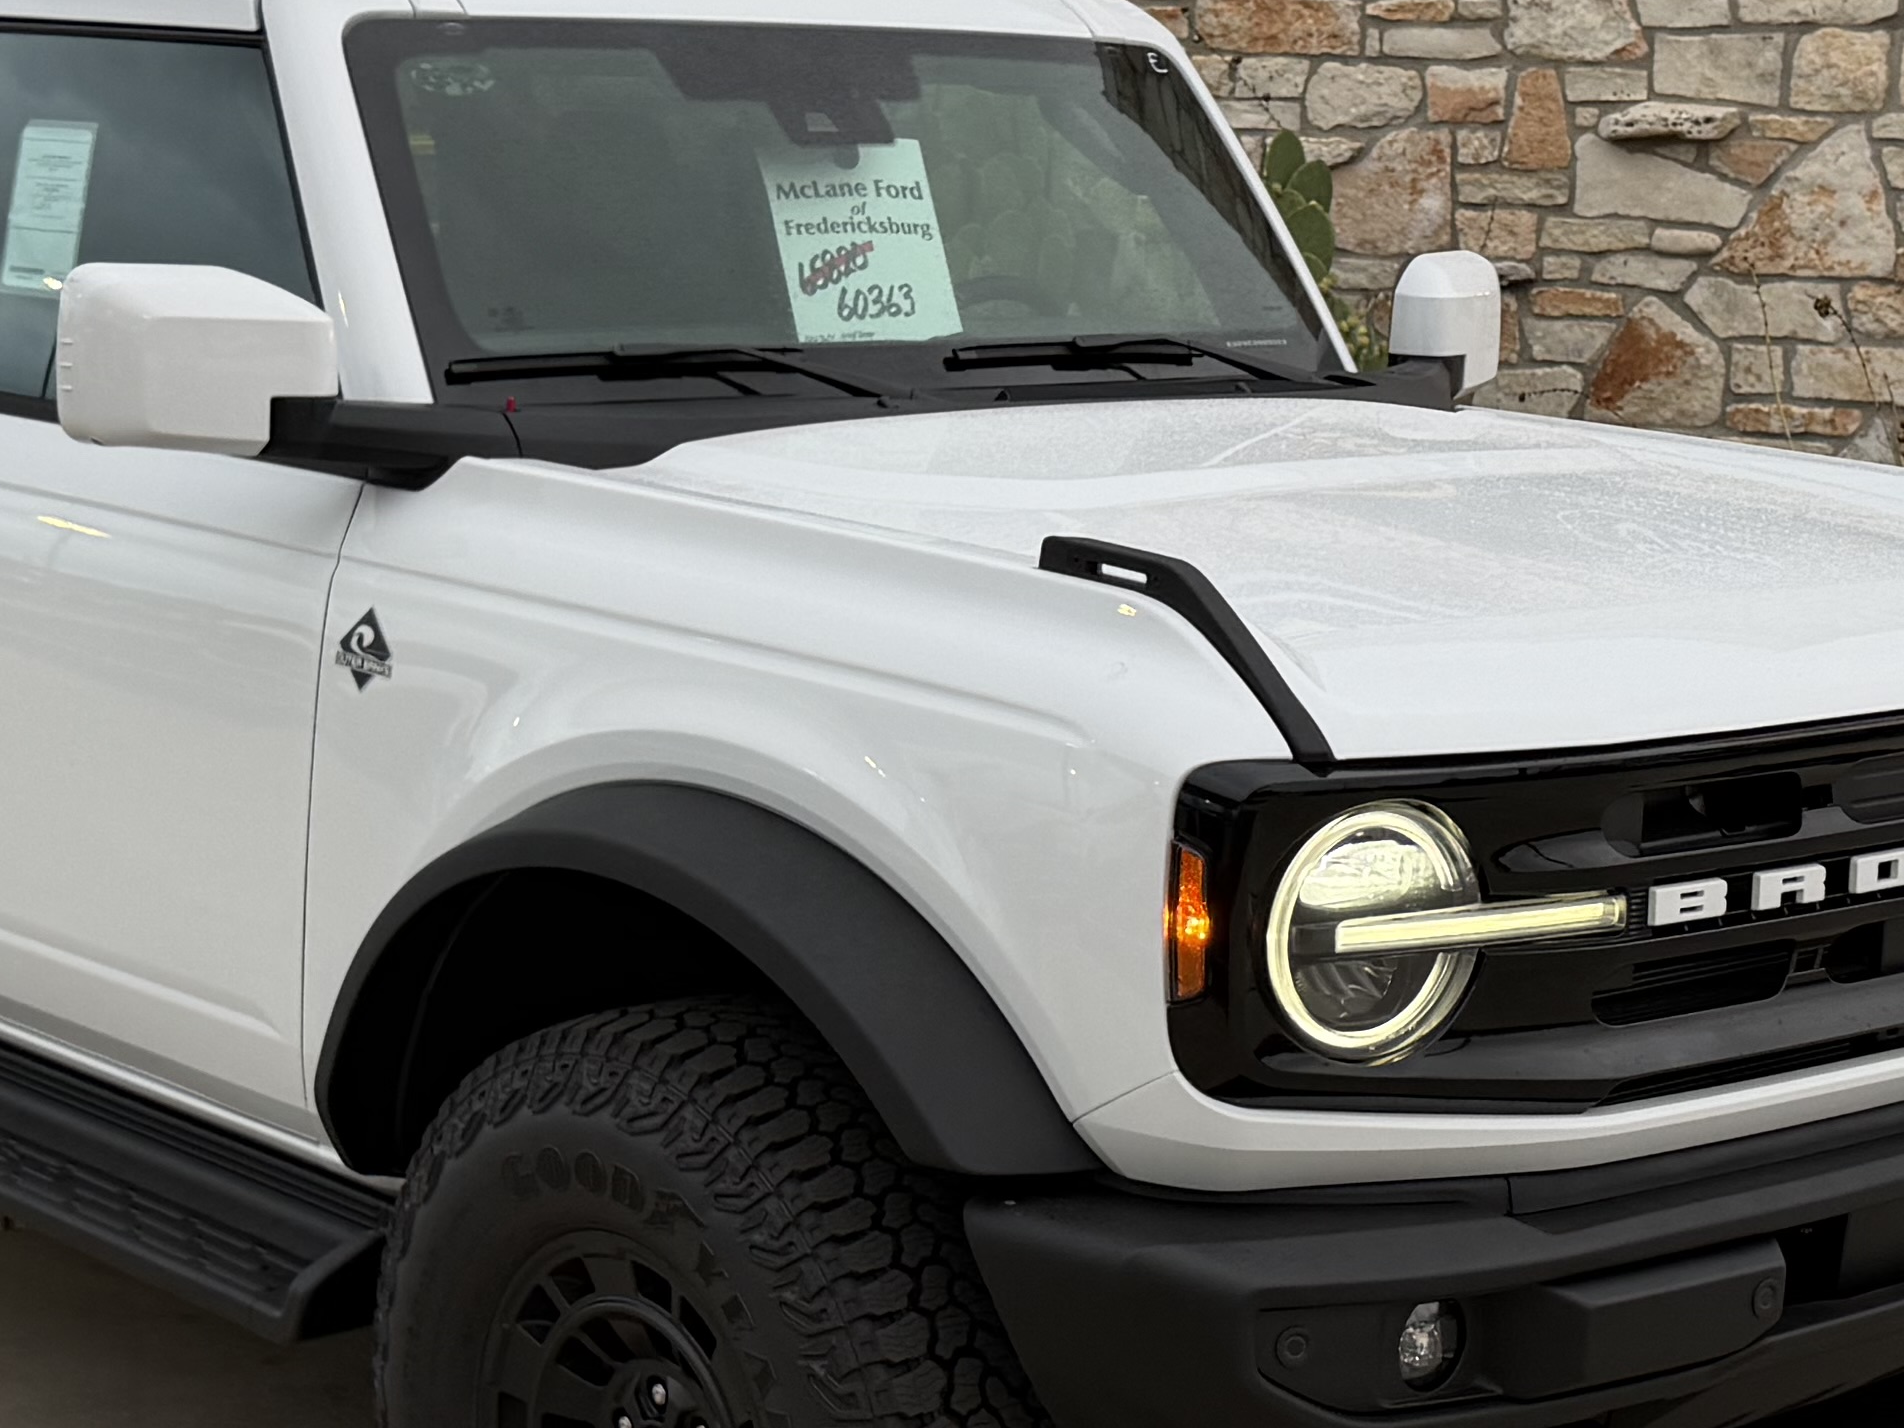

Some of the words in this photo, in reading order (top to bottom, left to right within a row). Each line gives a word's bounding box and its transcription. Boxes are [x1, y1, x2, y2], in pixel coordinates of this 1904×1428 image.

[776, 180, 868, 200] McLane
[873, 179, 924, 201] Ford
[850, 201, 867, 216] of
[783, 216, 934, 241] Fredericksburg
[837, 283, 916, 322] 60363
